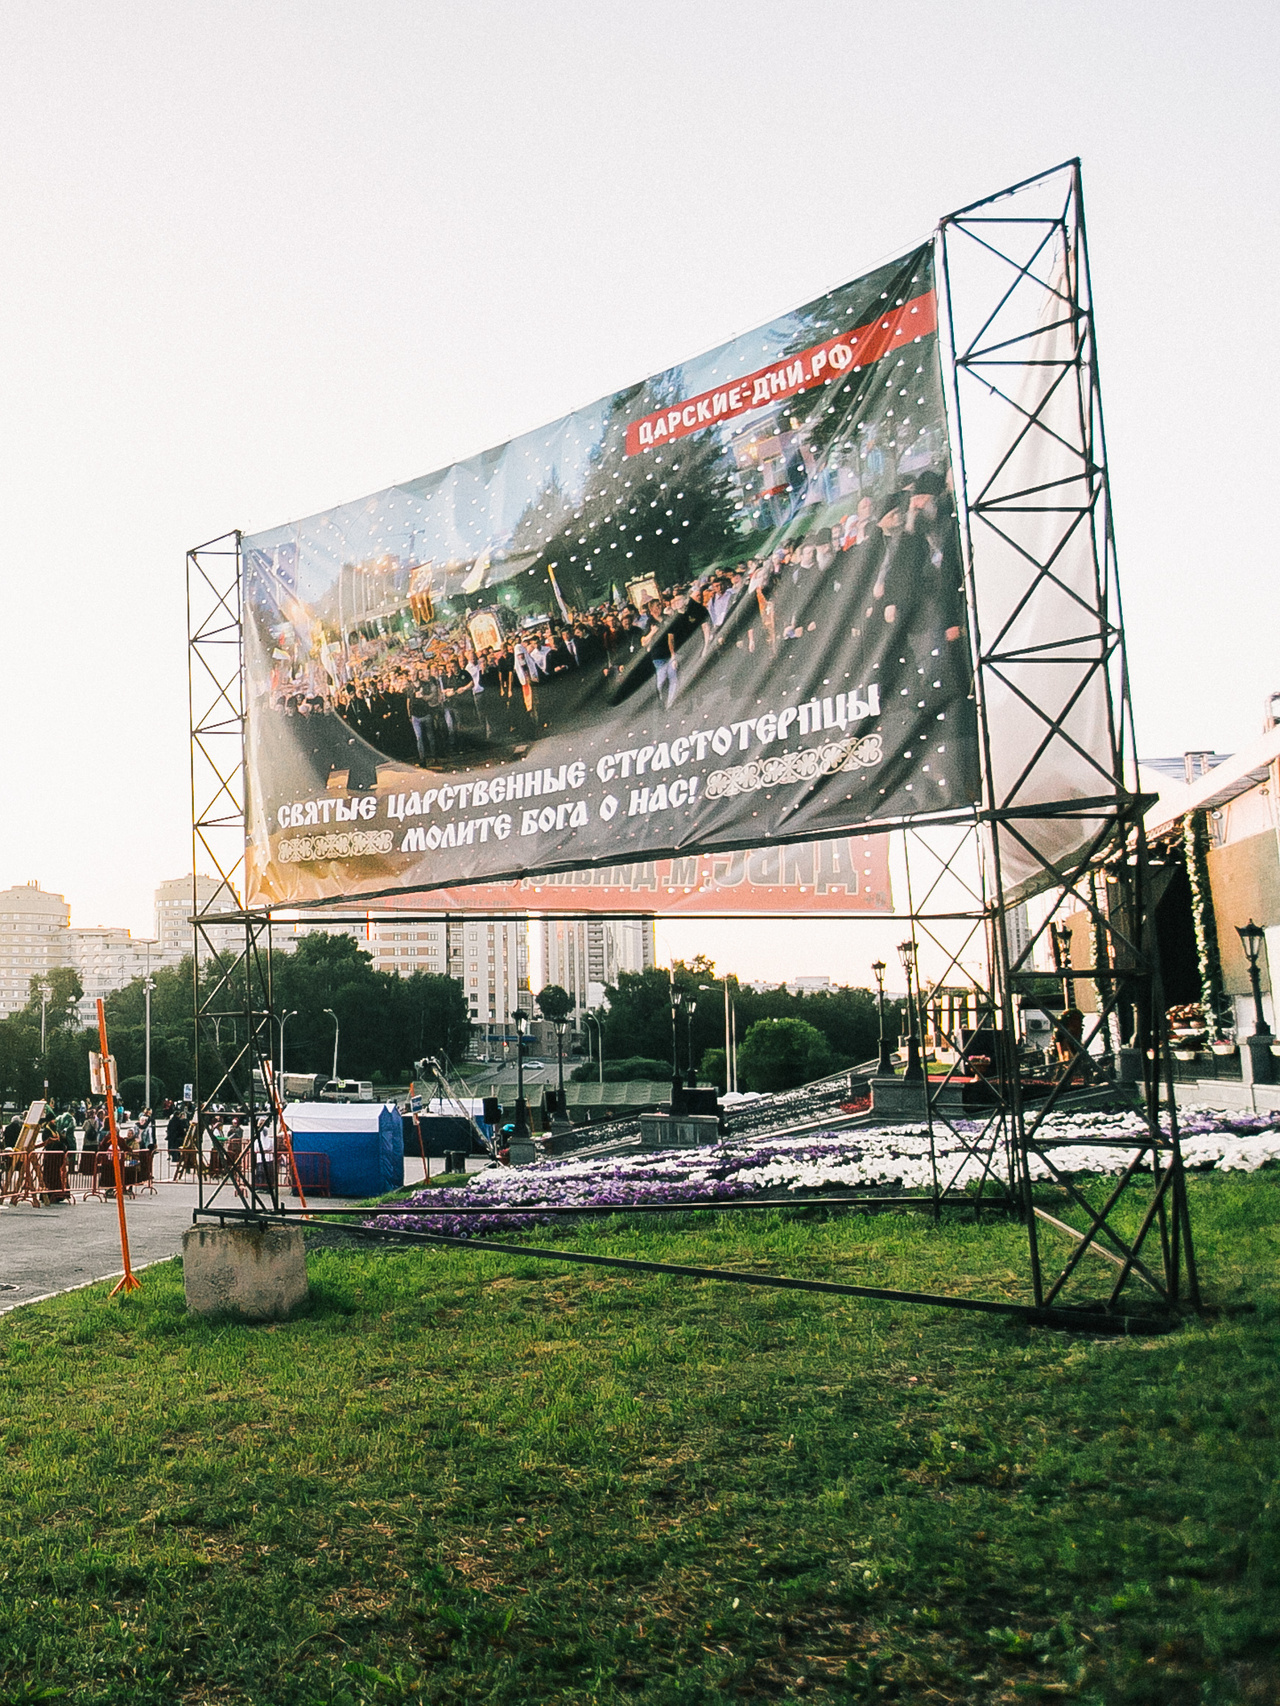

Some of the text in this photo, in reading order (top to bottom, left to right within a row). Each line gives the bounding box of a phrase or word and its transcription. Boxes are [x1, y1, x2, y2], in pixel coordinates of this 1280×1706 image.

[638, 343, 853, 446] ЦАРСКИЕ-ДНИ.РФ
[277, 684, 881, 829] СВЯТЫЕ ЦАРСТВЕННЫЕ СТРАСТОТЕРПЦЫ
[401, 776, 699, 853] МОЛИТЕ БОГА О НАС!
